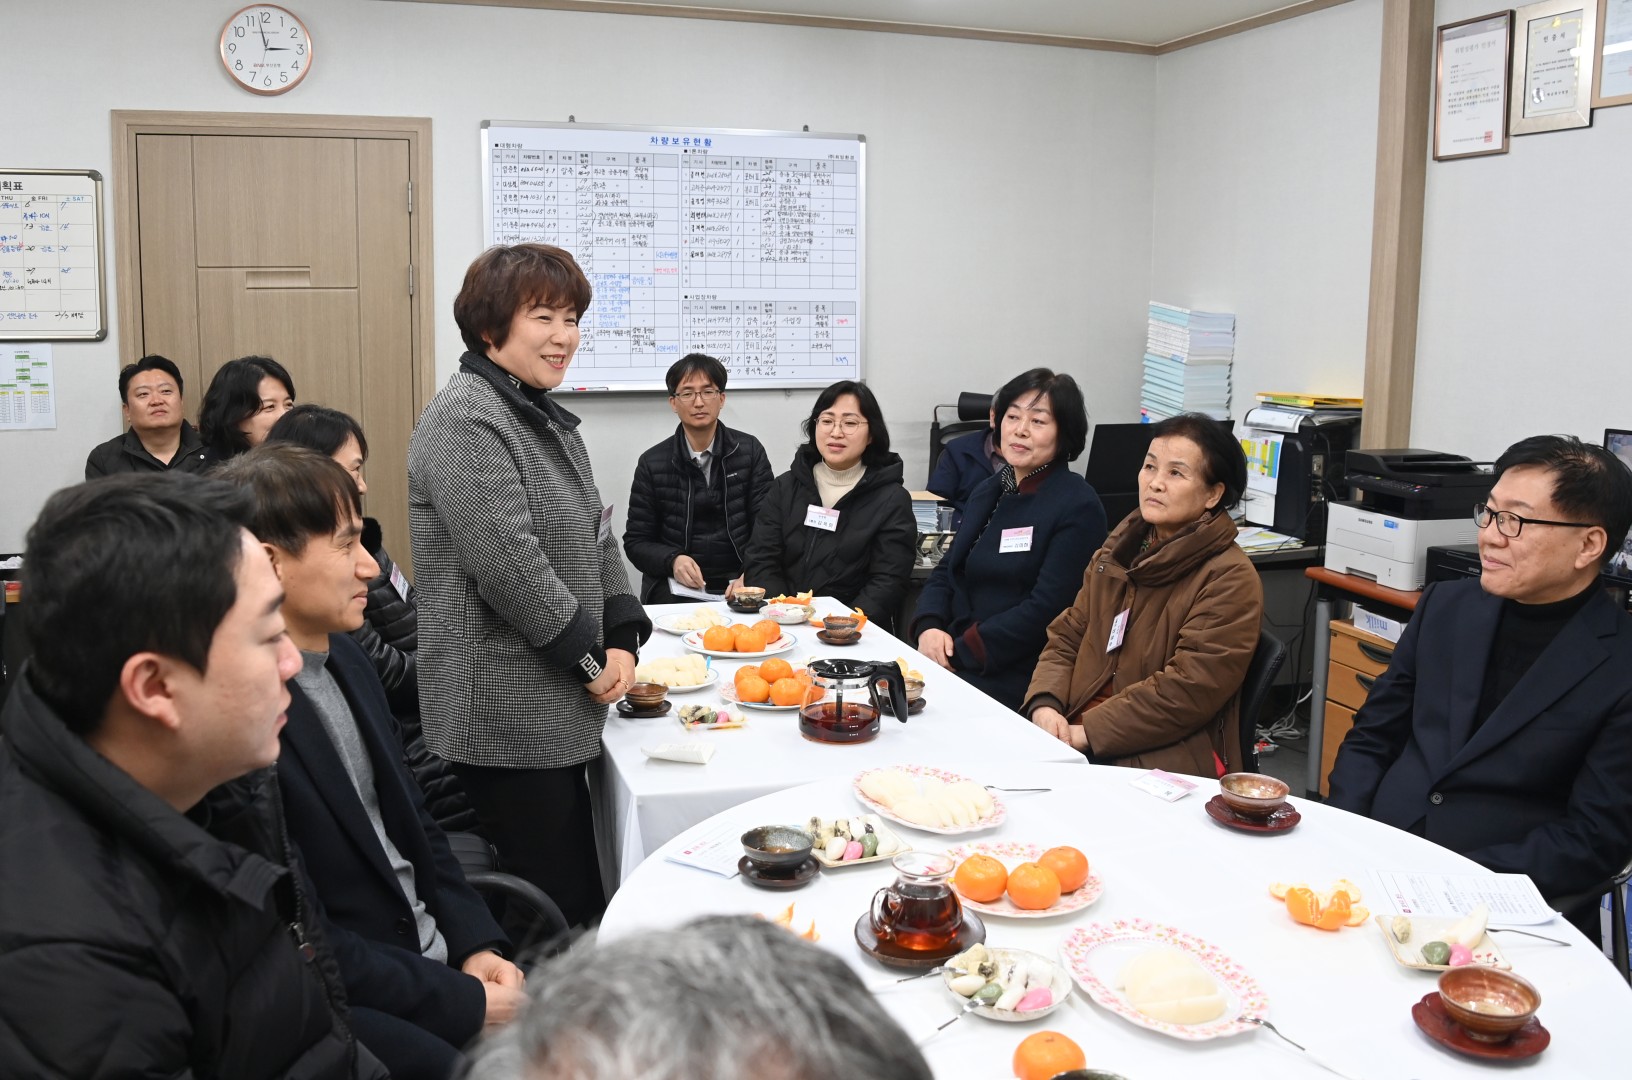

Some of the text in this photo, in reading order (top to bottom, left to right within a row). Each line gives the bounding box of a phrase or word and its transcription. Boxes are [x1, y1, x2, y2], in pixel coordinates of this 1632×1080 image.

[246, 16, 254, 27] 11
[260, 12, 270, 23] 12
[280, 16, 284, 27] 1
[234, 26, 245, 38] 10
[290, 27, 298, 38] 2
[228, 43, 236, 54] 9
[296, 44, 304, 55] 3
[234, 60, 244, 70] 8
[291, 60, 300, 70] 4
[249, 71, 256, 82] 7
[264, 75, 272, 86] 6
[280, 72, 288, 82] 5
[650, 136, 712, 146] 차량보유현황
[1366, 614, 1388, 631] miilk
